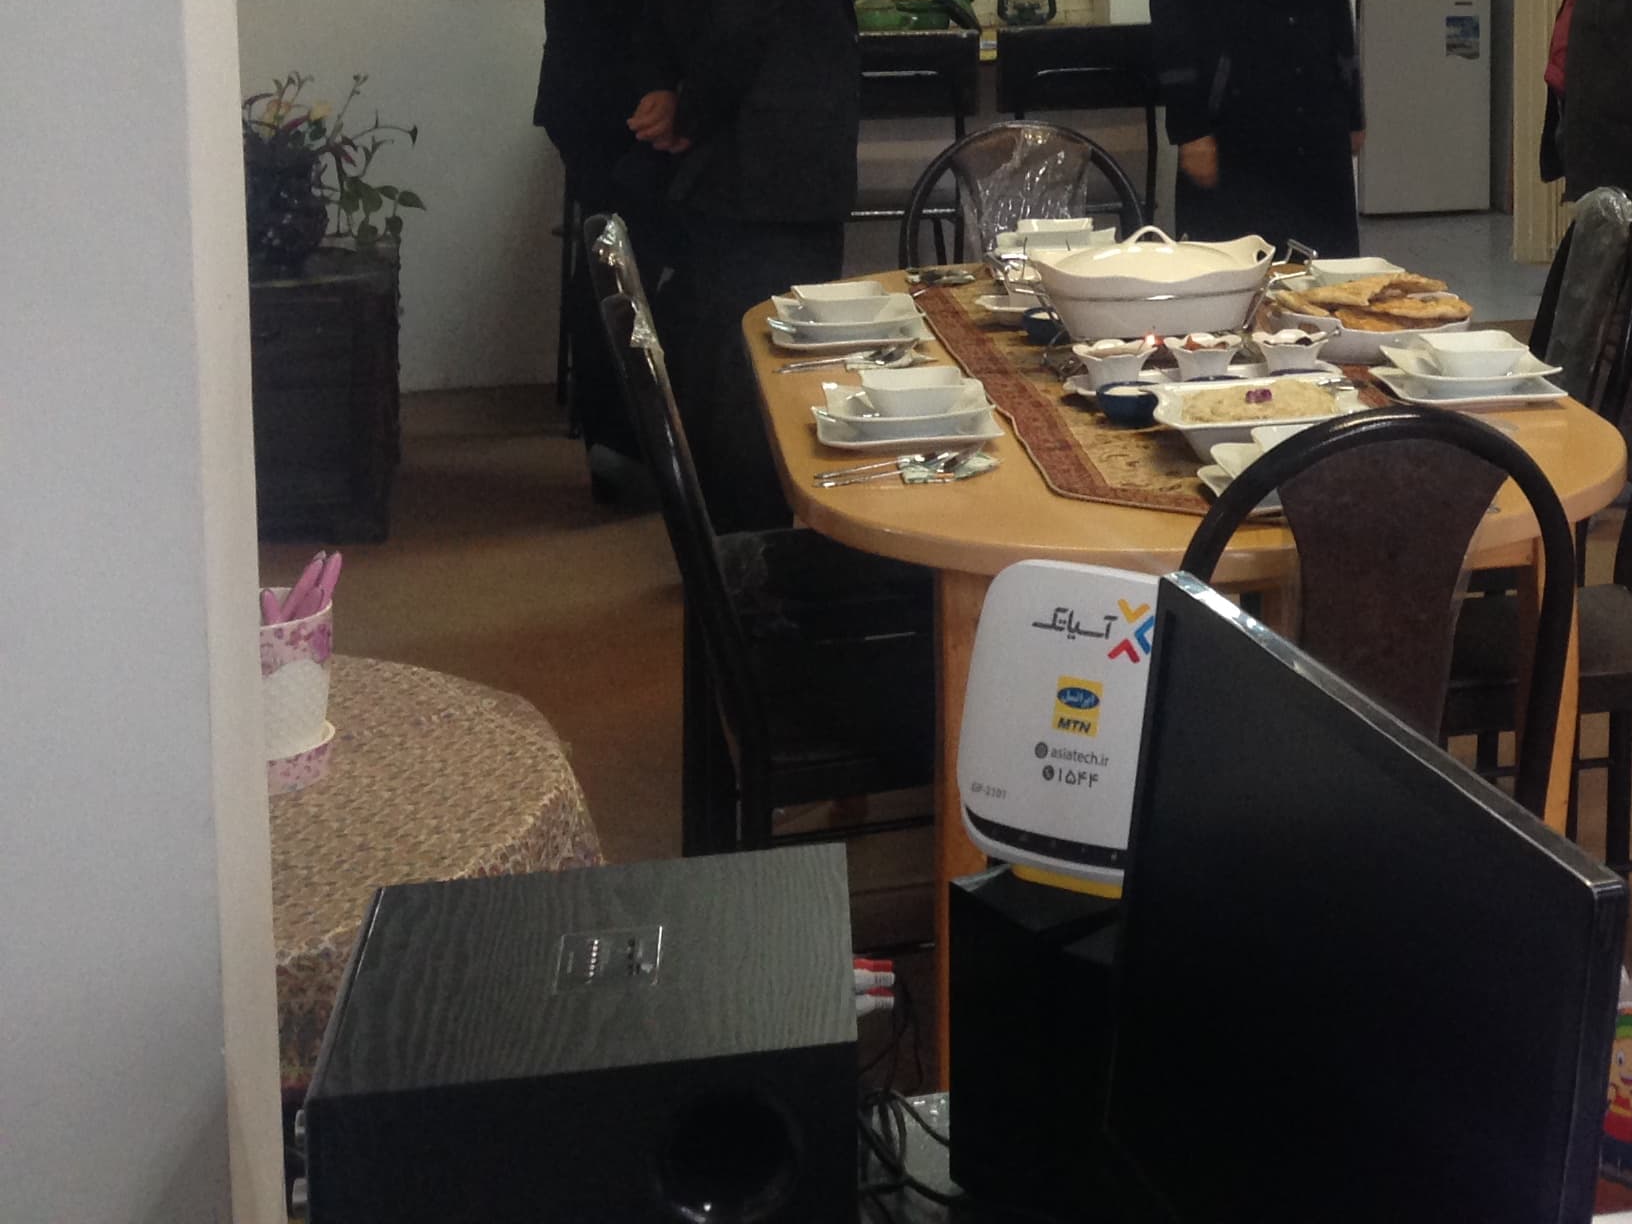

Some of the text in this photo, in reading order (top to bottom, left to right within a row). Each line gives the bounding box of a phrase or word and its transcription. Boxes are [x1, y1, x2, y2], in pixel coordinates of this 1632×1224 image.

[1031, 607, 1118, 641] آسیاتک
[1055, 717, 1092, 734] MTN
[1050, 747, 1109, 768] asiatech.ir
[1058, 770, 1099, 788] ۱۵۴۴
